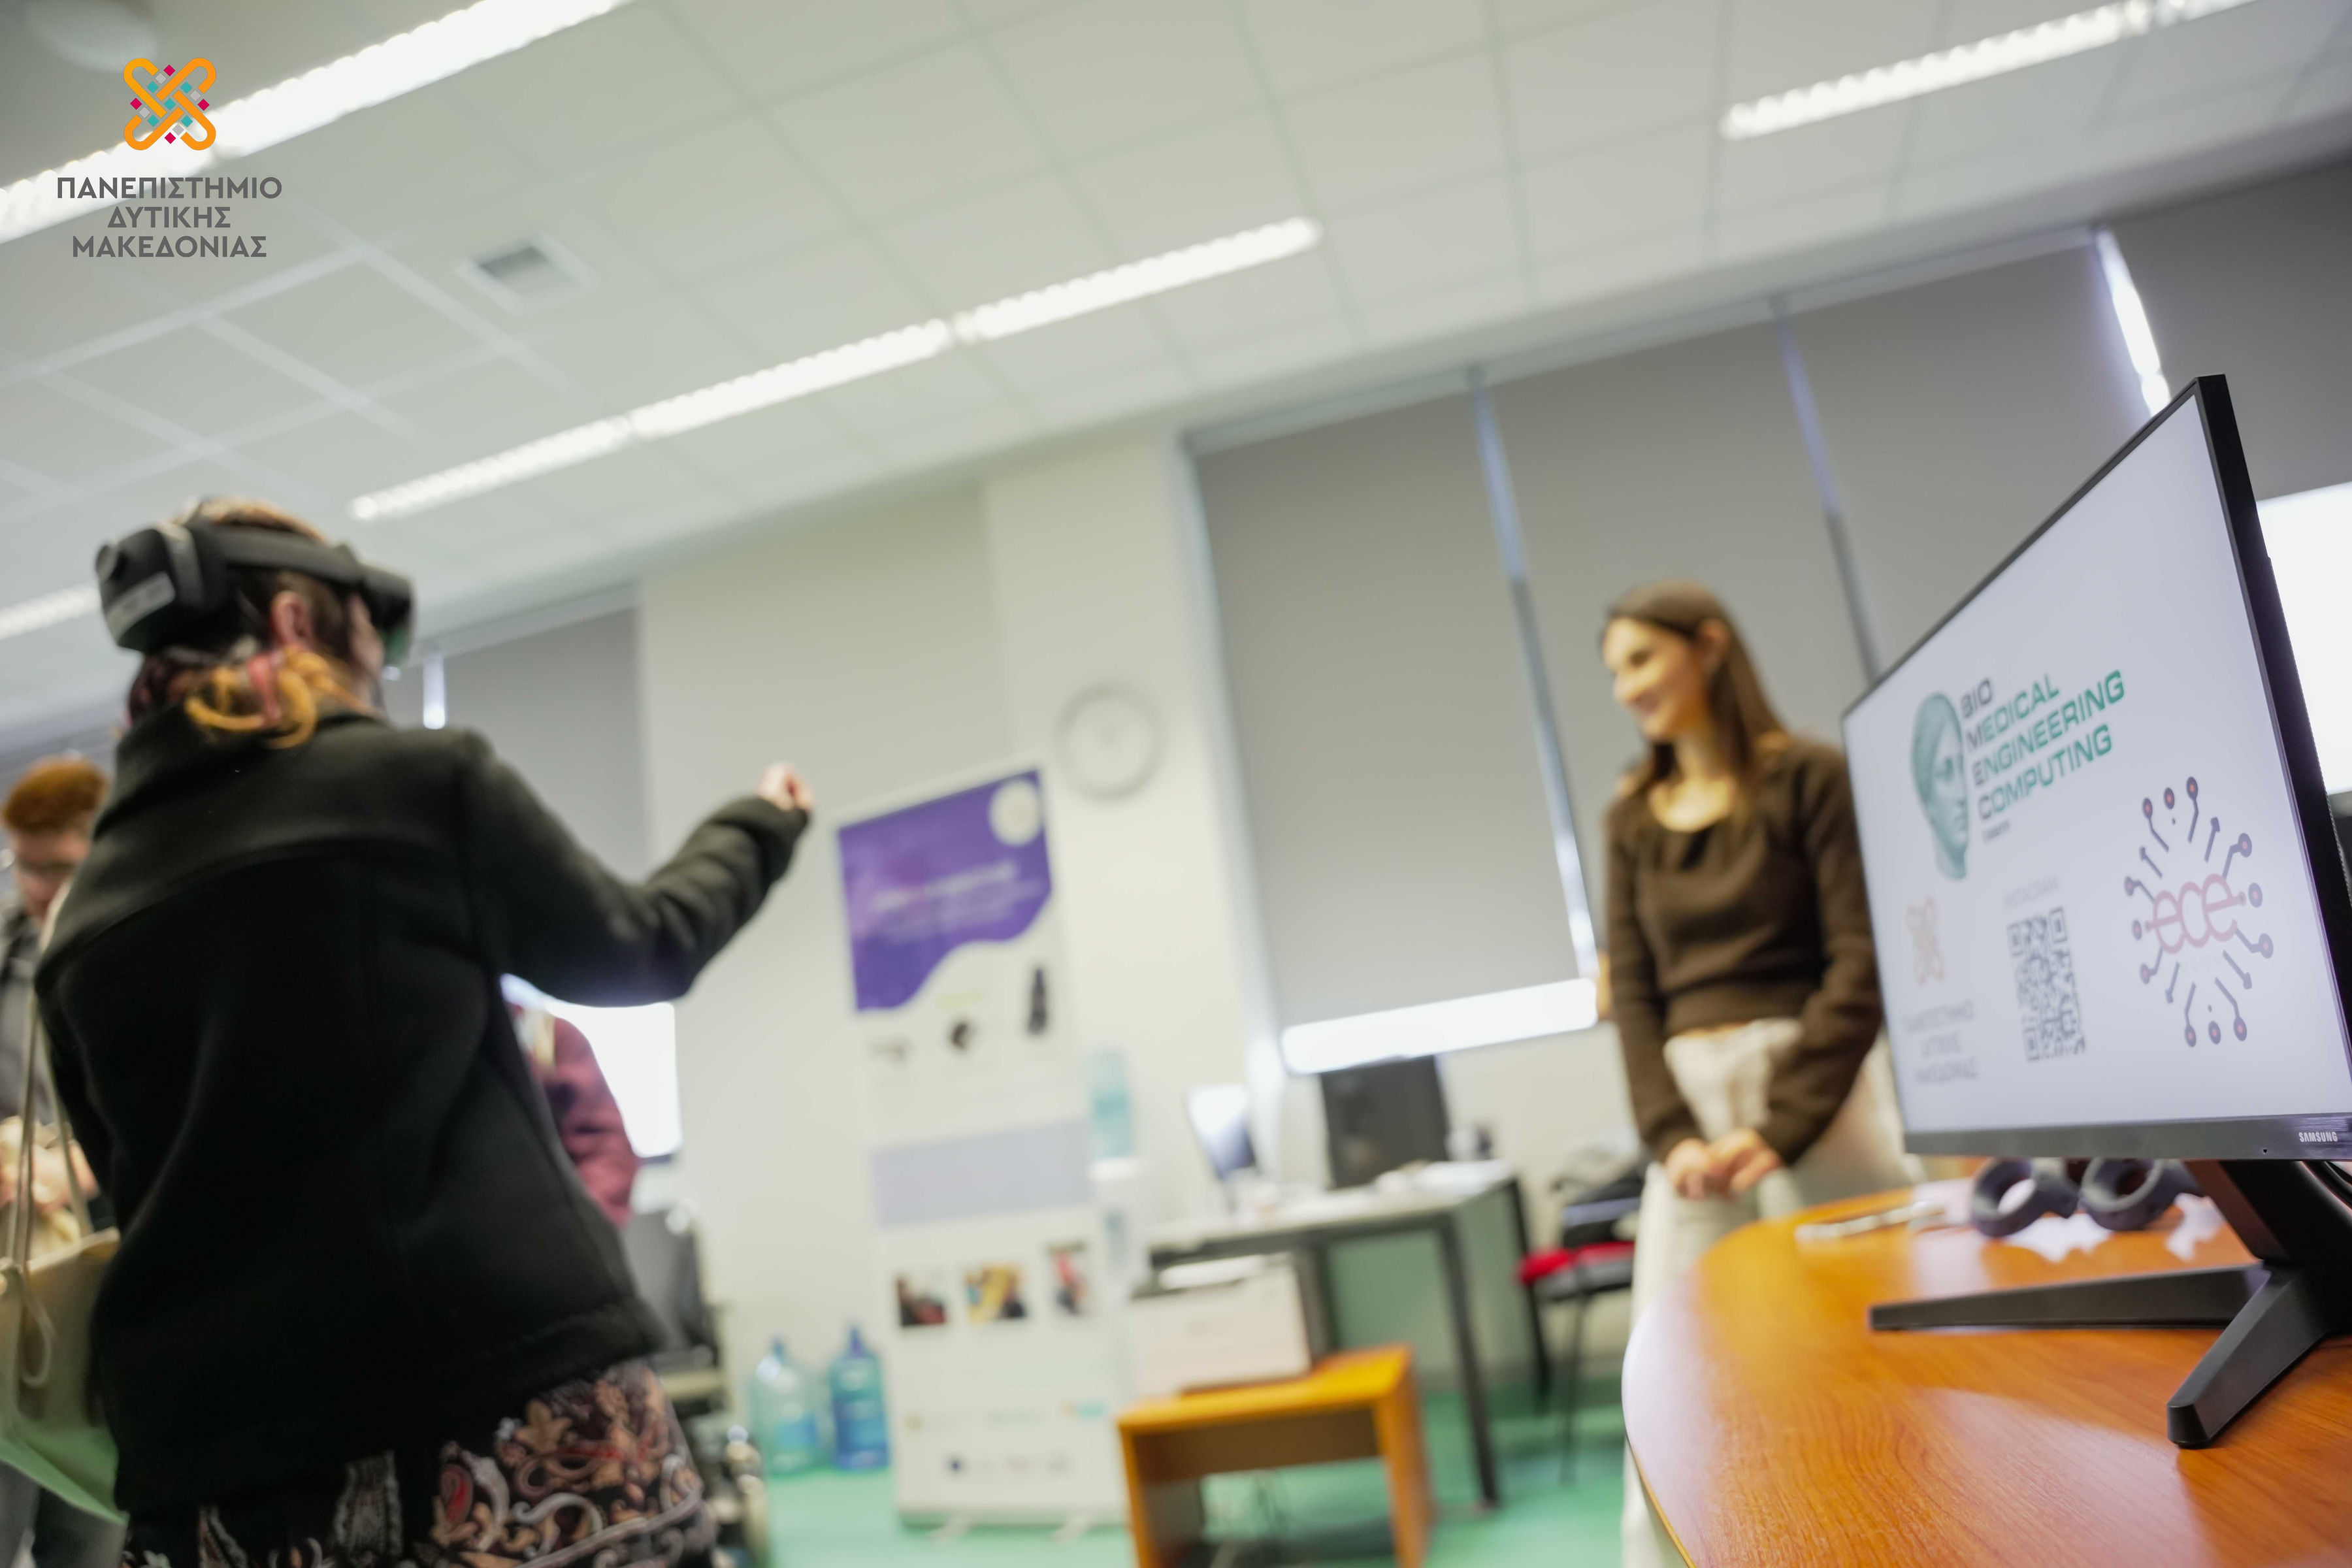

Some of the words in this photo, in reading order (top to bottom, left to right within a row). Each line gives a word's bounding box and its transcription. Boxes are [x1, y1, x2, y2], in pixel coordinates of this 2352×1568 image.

[1960, 678, 1993, 719] BIO
[1966, 673, 2060, 751] MEDICAL
[1972, 669, 2126, 787] ENGINEERING
[1977, 723, 2113, 821] COMPUTING
[2298, 1131, 2338, 1143] SAMSUNG
